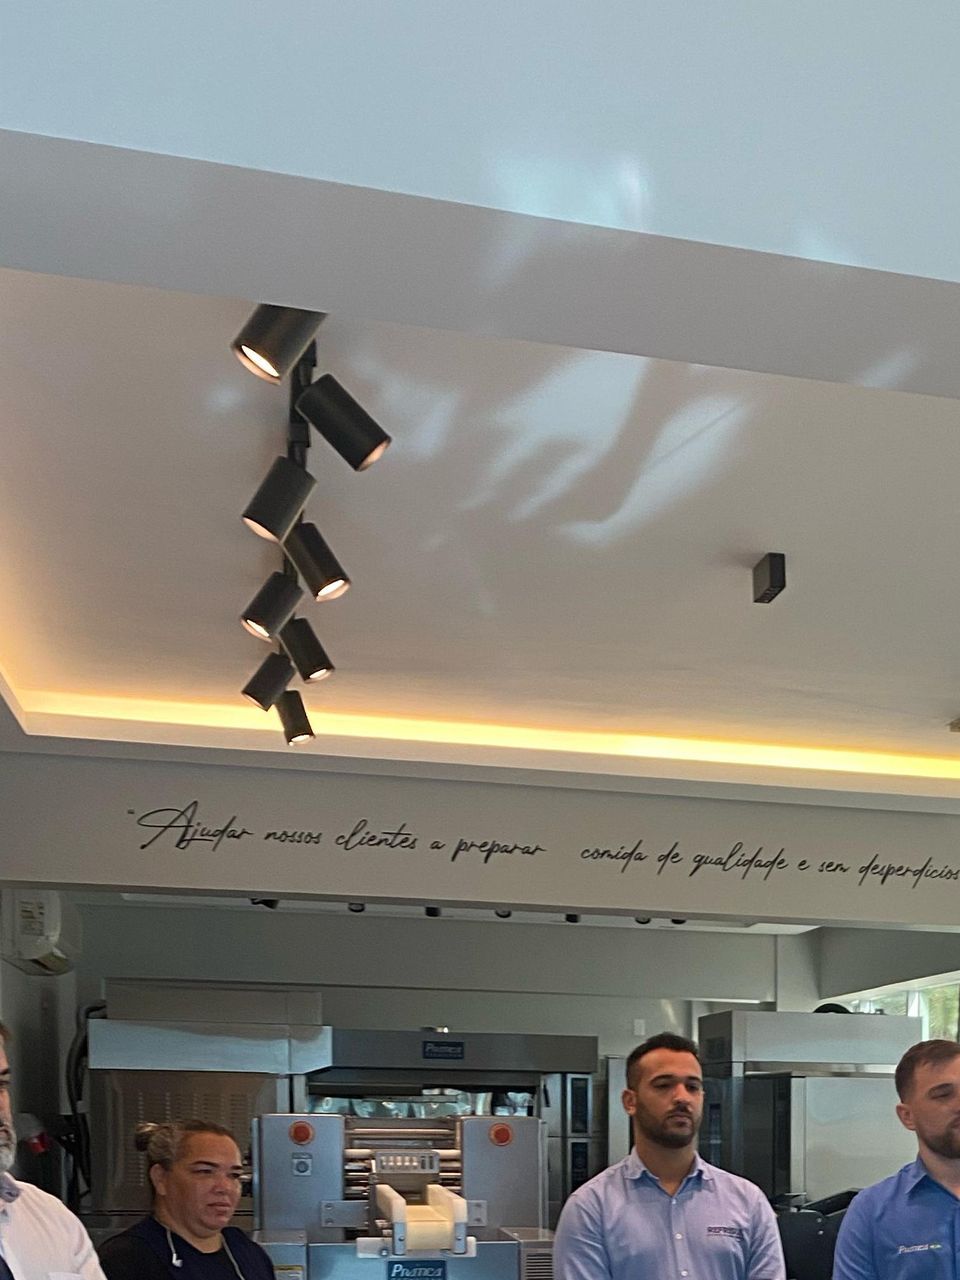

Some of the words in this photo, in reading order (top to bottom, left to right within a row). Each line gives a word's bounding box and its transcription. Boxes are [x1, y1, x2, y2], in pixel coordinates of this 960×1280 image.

[264, 829, 322, 845] nossos
[335, 819, 417, 851] clientes
[429, 839, 446, 851] a
[451, 838, 547, 863] preparar
[580, 839, 649, 874] comida
[656, 841, 684, 876] de
[689, 841, 789, 881] qualidade
[798, 858, 810, 871] e
[818, 860, 850, 873] sem
